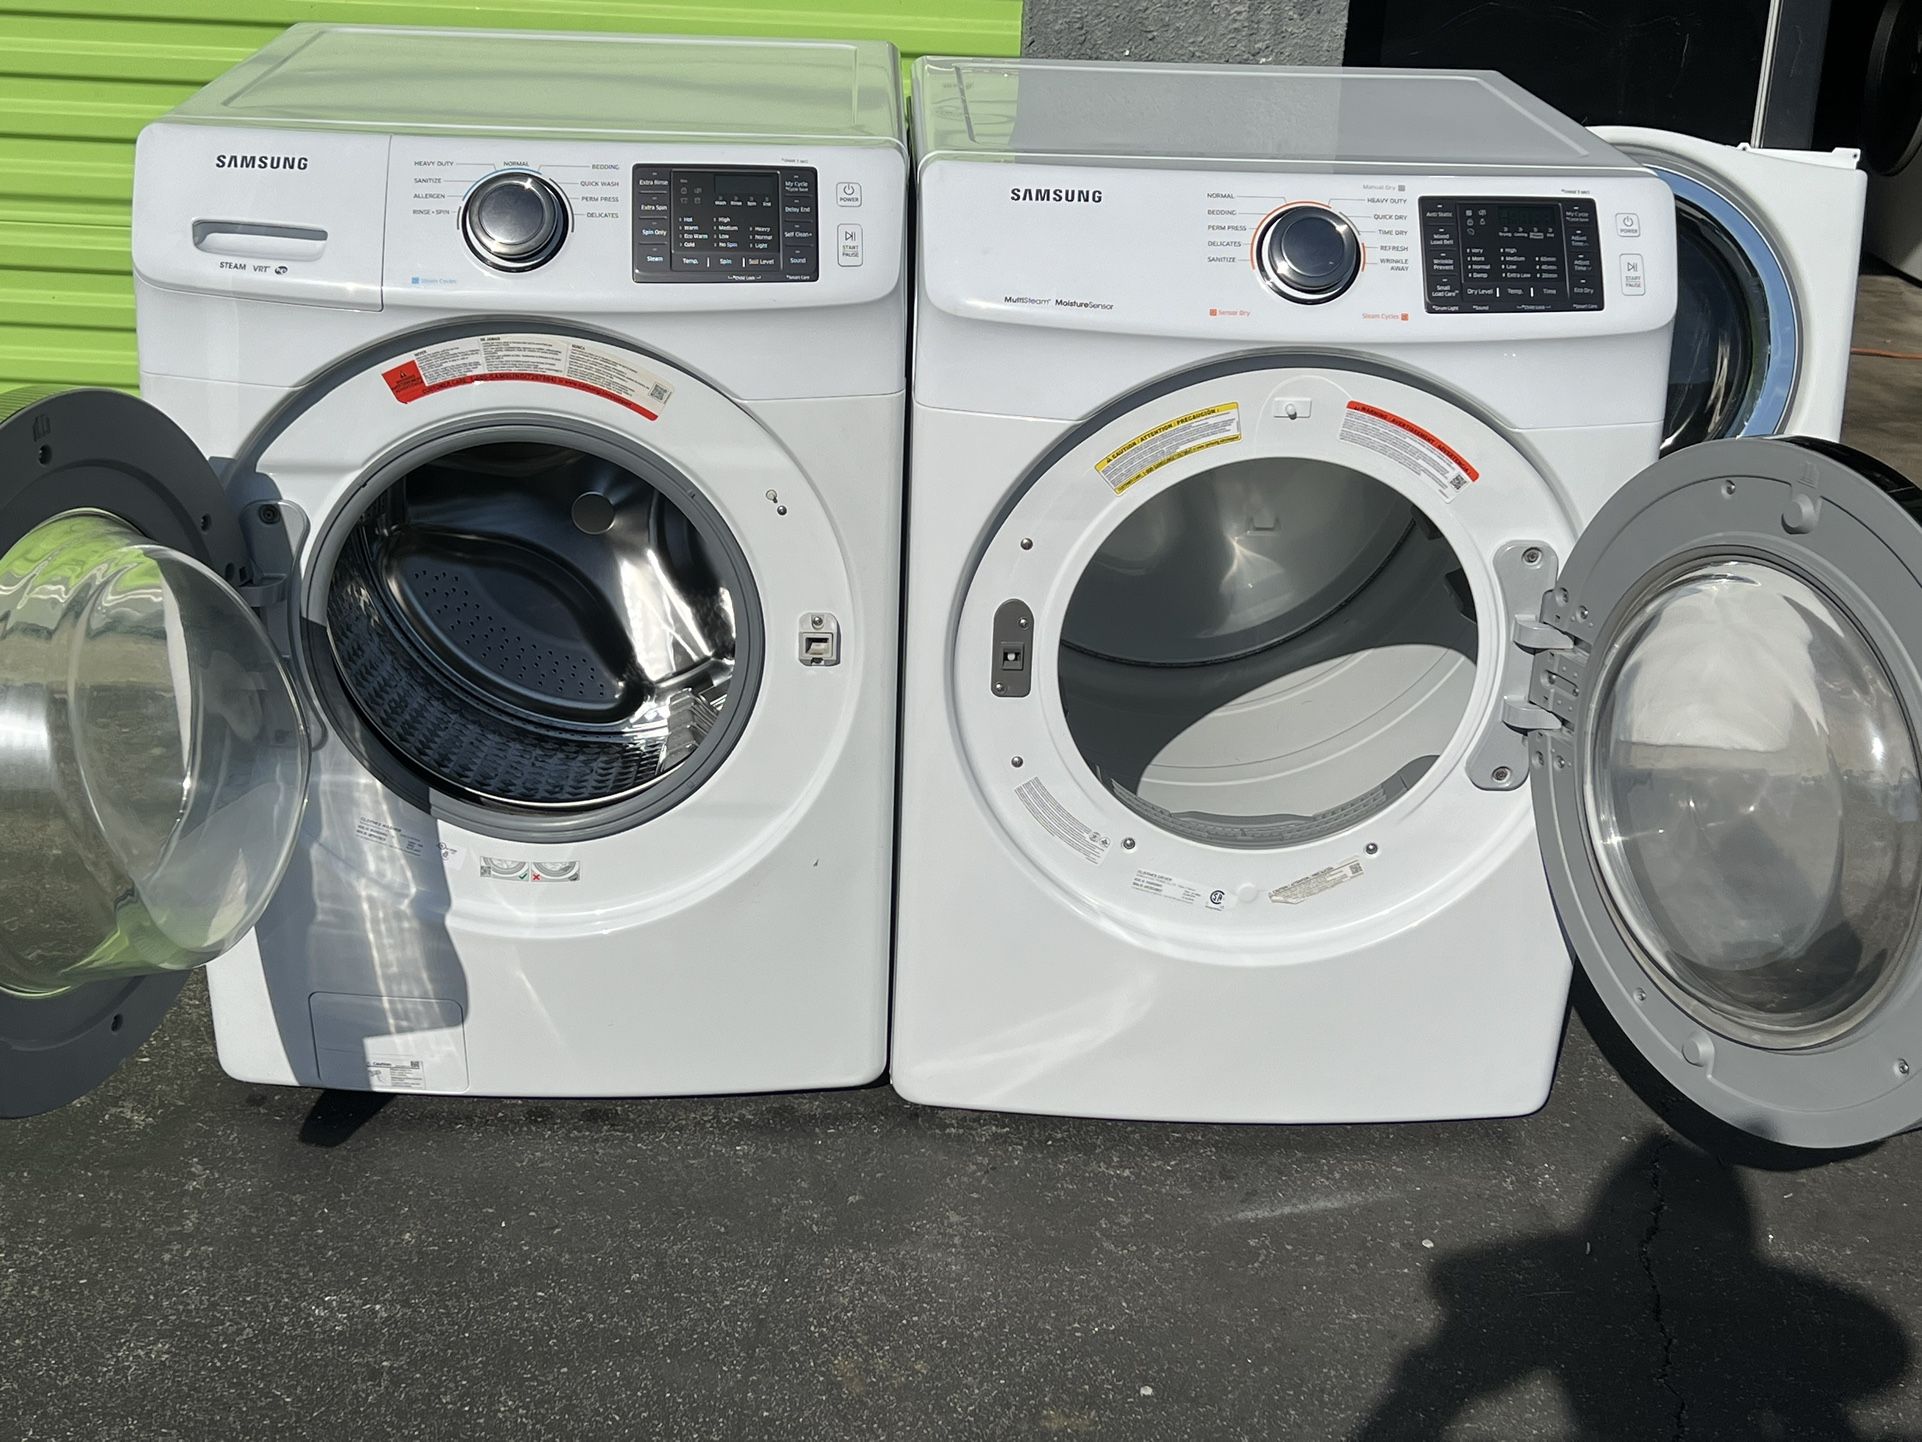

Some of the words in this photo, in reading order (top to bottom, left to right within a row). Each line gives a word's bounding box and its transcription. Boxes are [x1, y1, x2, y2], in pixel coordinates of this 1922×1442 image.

[216, 155, 308, 170] SAMSUNG
[1011, 188, 1103, 203] SAMSUNG
[220, 262, 246, 271] STEAM
[1055, 299, 1114, 310] MoistureSensor
[1112, 441, 1136, 459] CAUTION
[1140, 423, 1173, 442] ATTENTION
